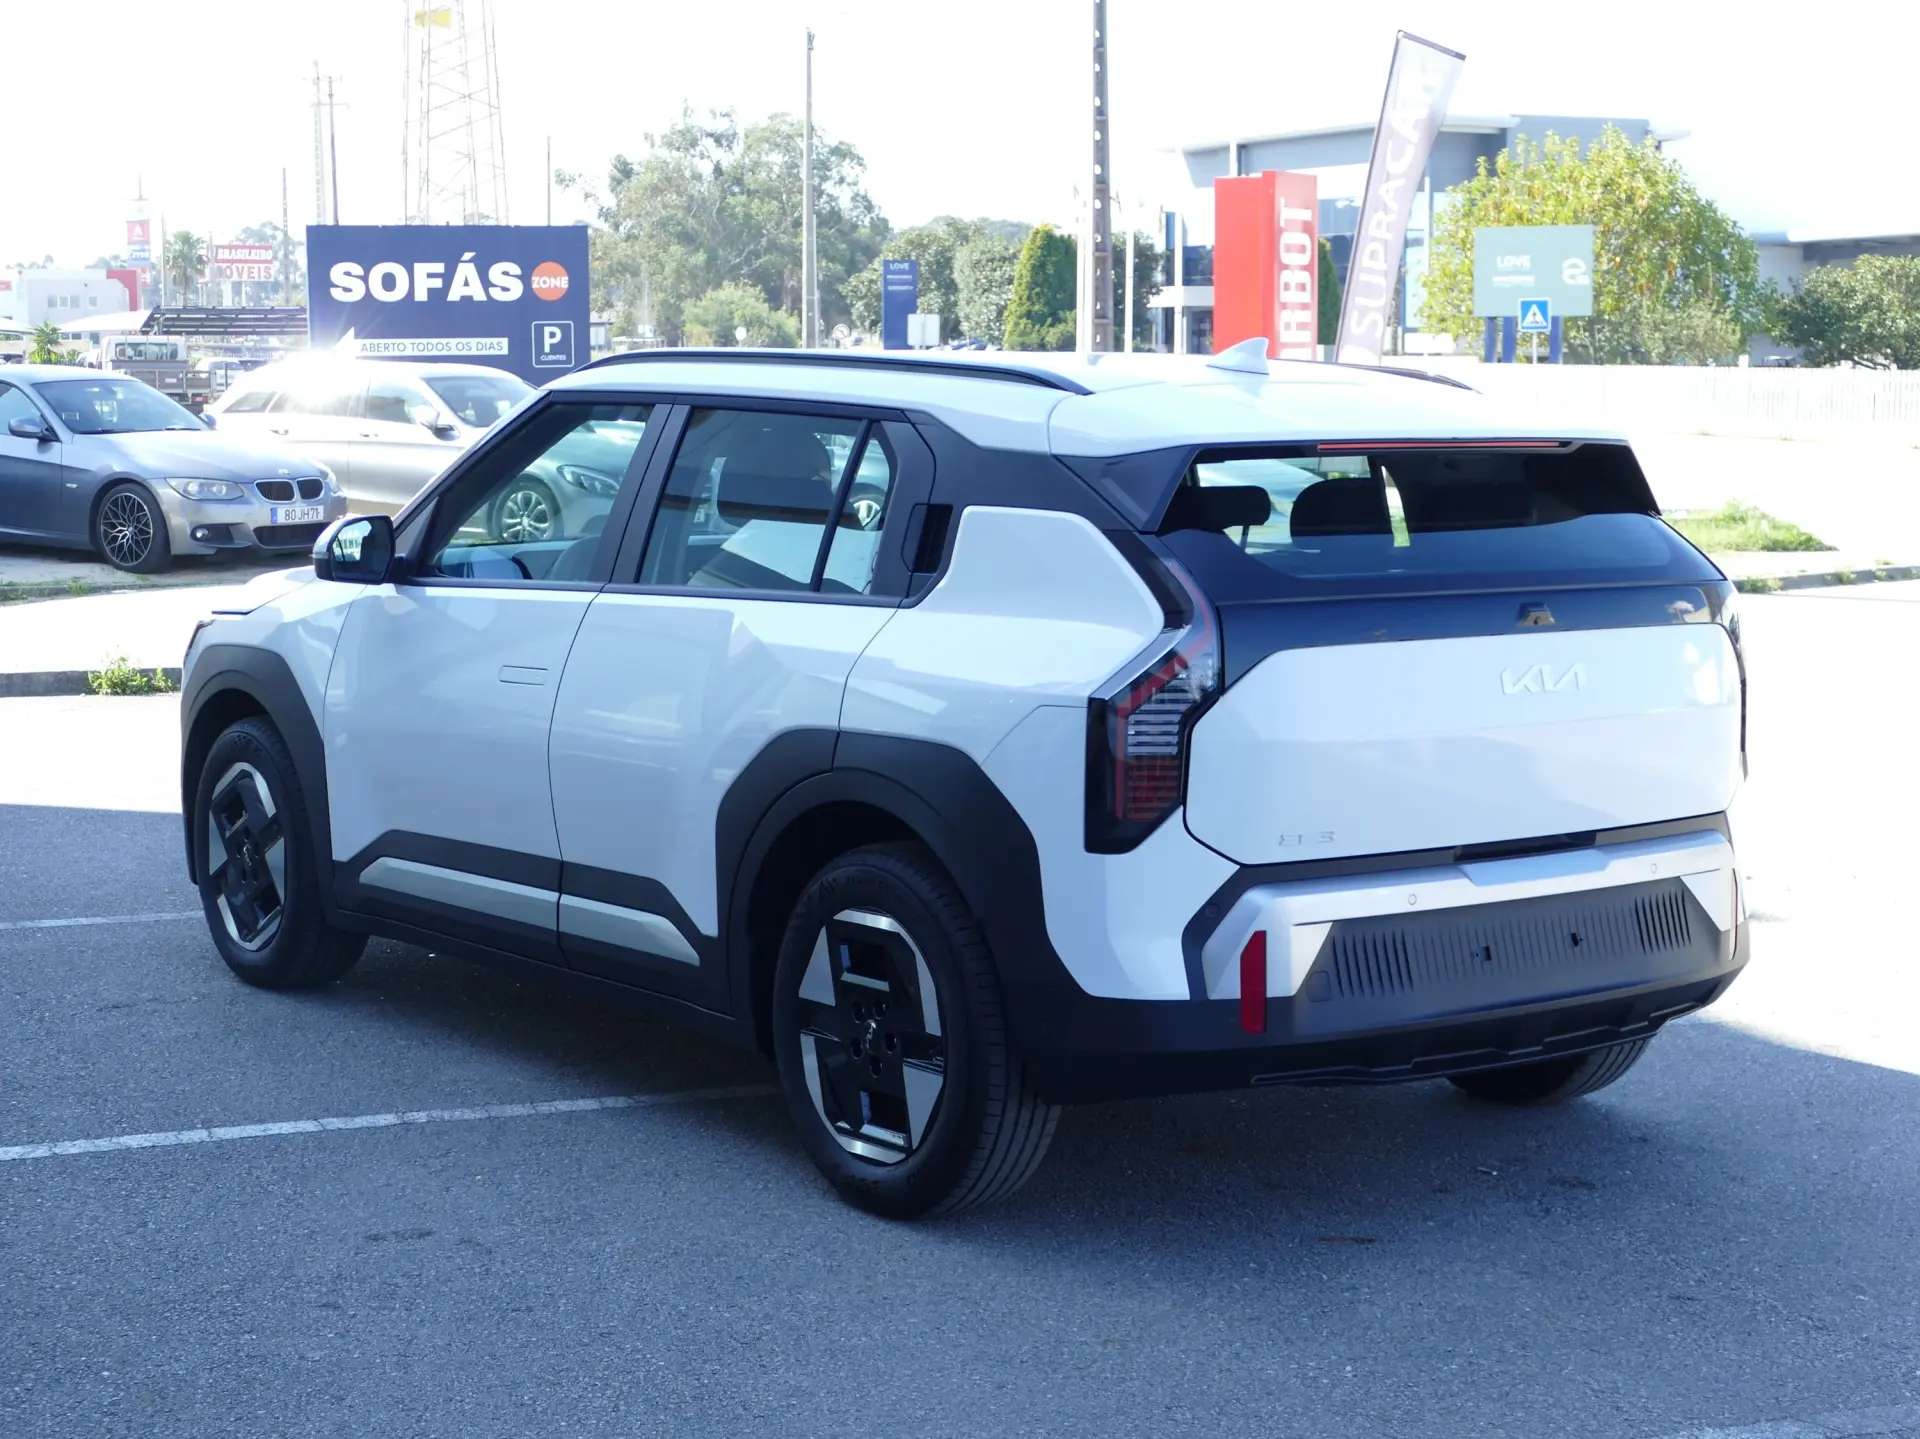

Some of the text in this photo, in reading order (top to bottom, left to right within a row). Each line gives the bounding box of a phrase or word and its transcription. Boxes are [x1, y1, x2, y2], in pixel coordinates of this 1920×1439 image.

[329, 252, 569, 303] SOFÁS ZONE
[1497, 255, 1532, 269] LOVE
[1279, 197, 1312, 361] RBOT
[360, 341, 503, 353] ABERTO TODOS OS DIAS
[543, 326, 562, 353] P
[1501, 661, 1585, 696] KIA
